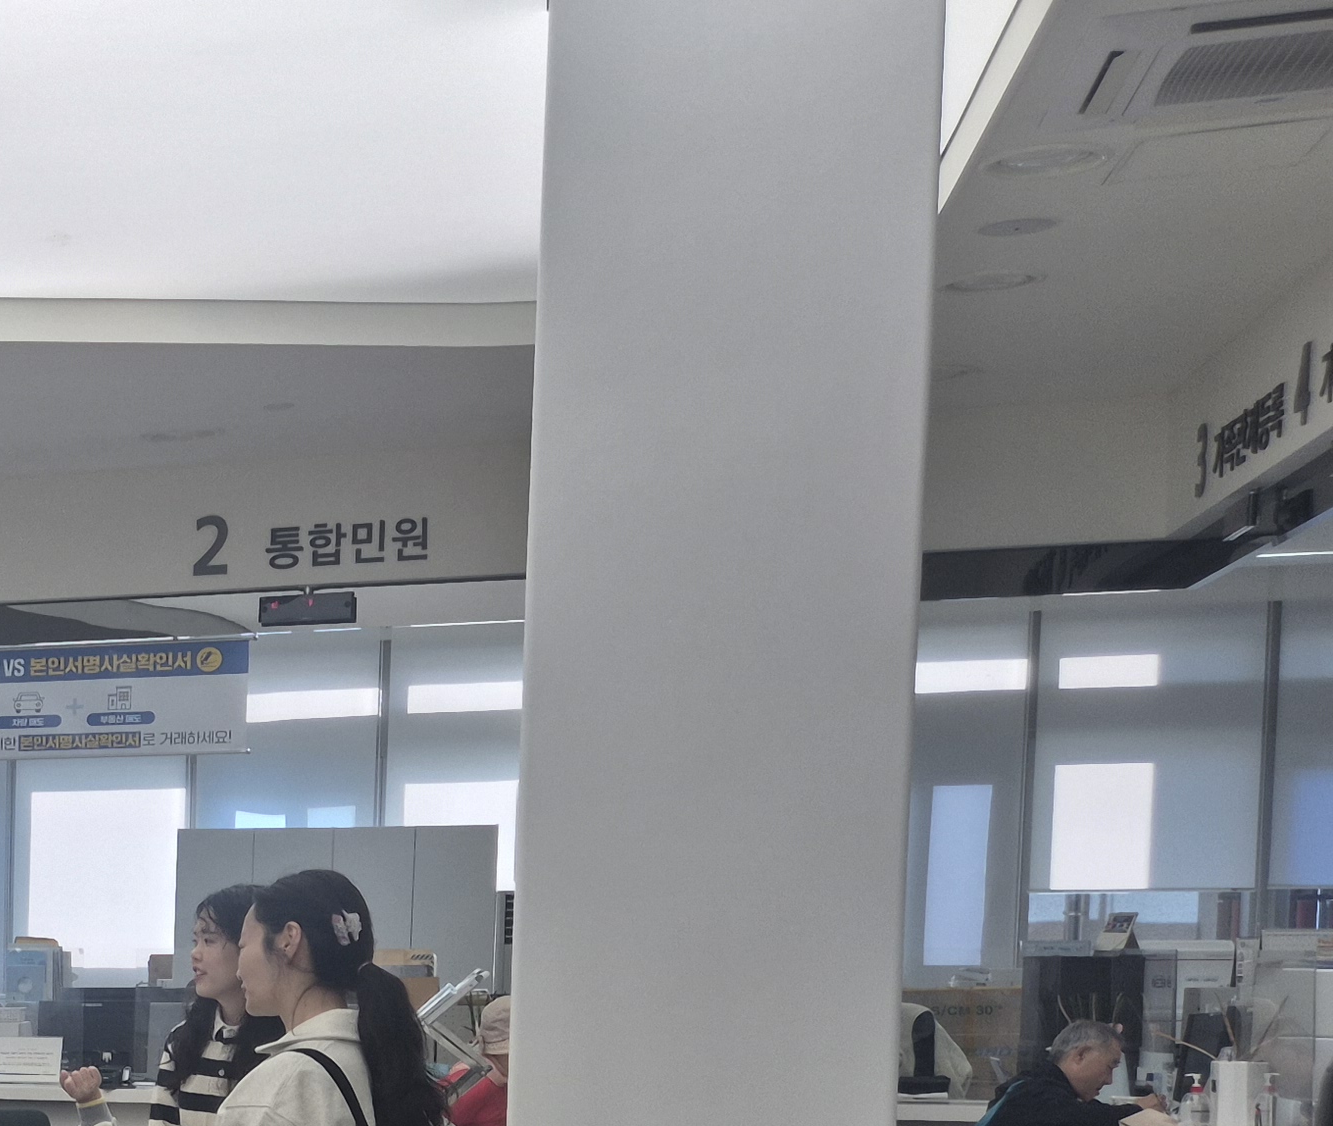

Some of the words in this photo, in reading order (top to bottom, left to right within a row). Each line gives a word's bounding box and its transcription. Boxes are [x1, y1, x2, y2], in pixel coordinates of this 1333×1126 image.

[1293, 340, 1312, 426] 4
[1194, 422, 1208, 498] 3
[192, 516, 230, 576] 2
[264, 516, 430, 570] 통합민원
[3, 658, 25, 678] VS
[29, 650, 192, 677] 본인서명사실확인서
[159, 729, 232, 747] 거래하세요!
